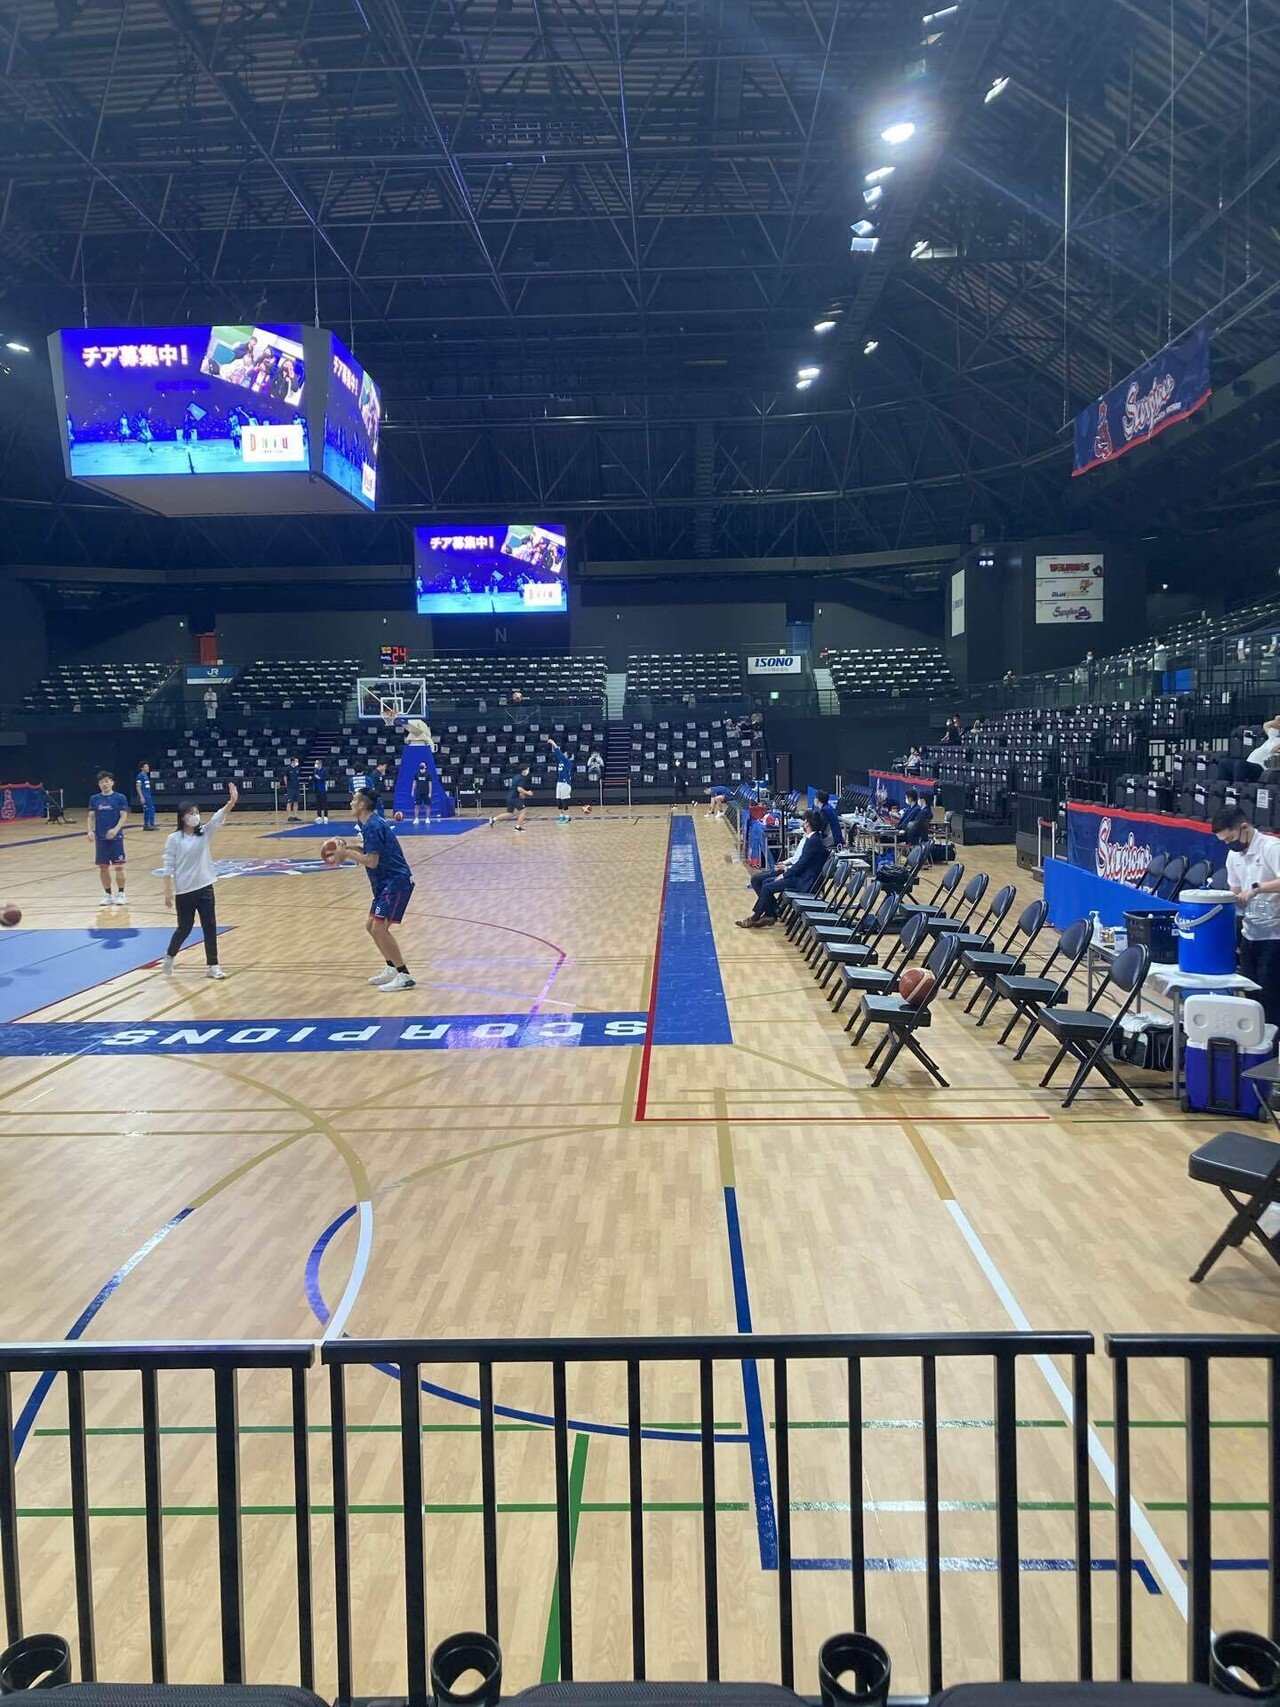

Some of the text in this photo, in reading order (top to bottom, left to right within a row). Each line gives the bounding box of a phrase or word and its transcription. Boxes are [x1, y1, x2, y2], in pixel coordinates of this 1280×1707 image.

[494, 626, 508, 643] N
[392, 646, 408, 663] 24
[754, 657, 794, 668] ISONO
[206, 668, 220, 676] JR
[101, 1020, 648, 1046] SCORPIONS
